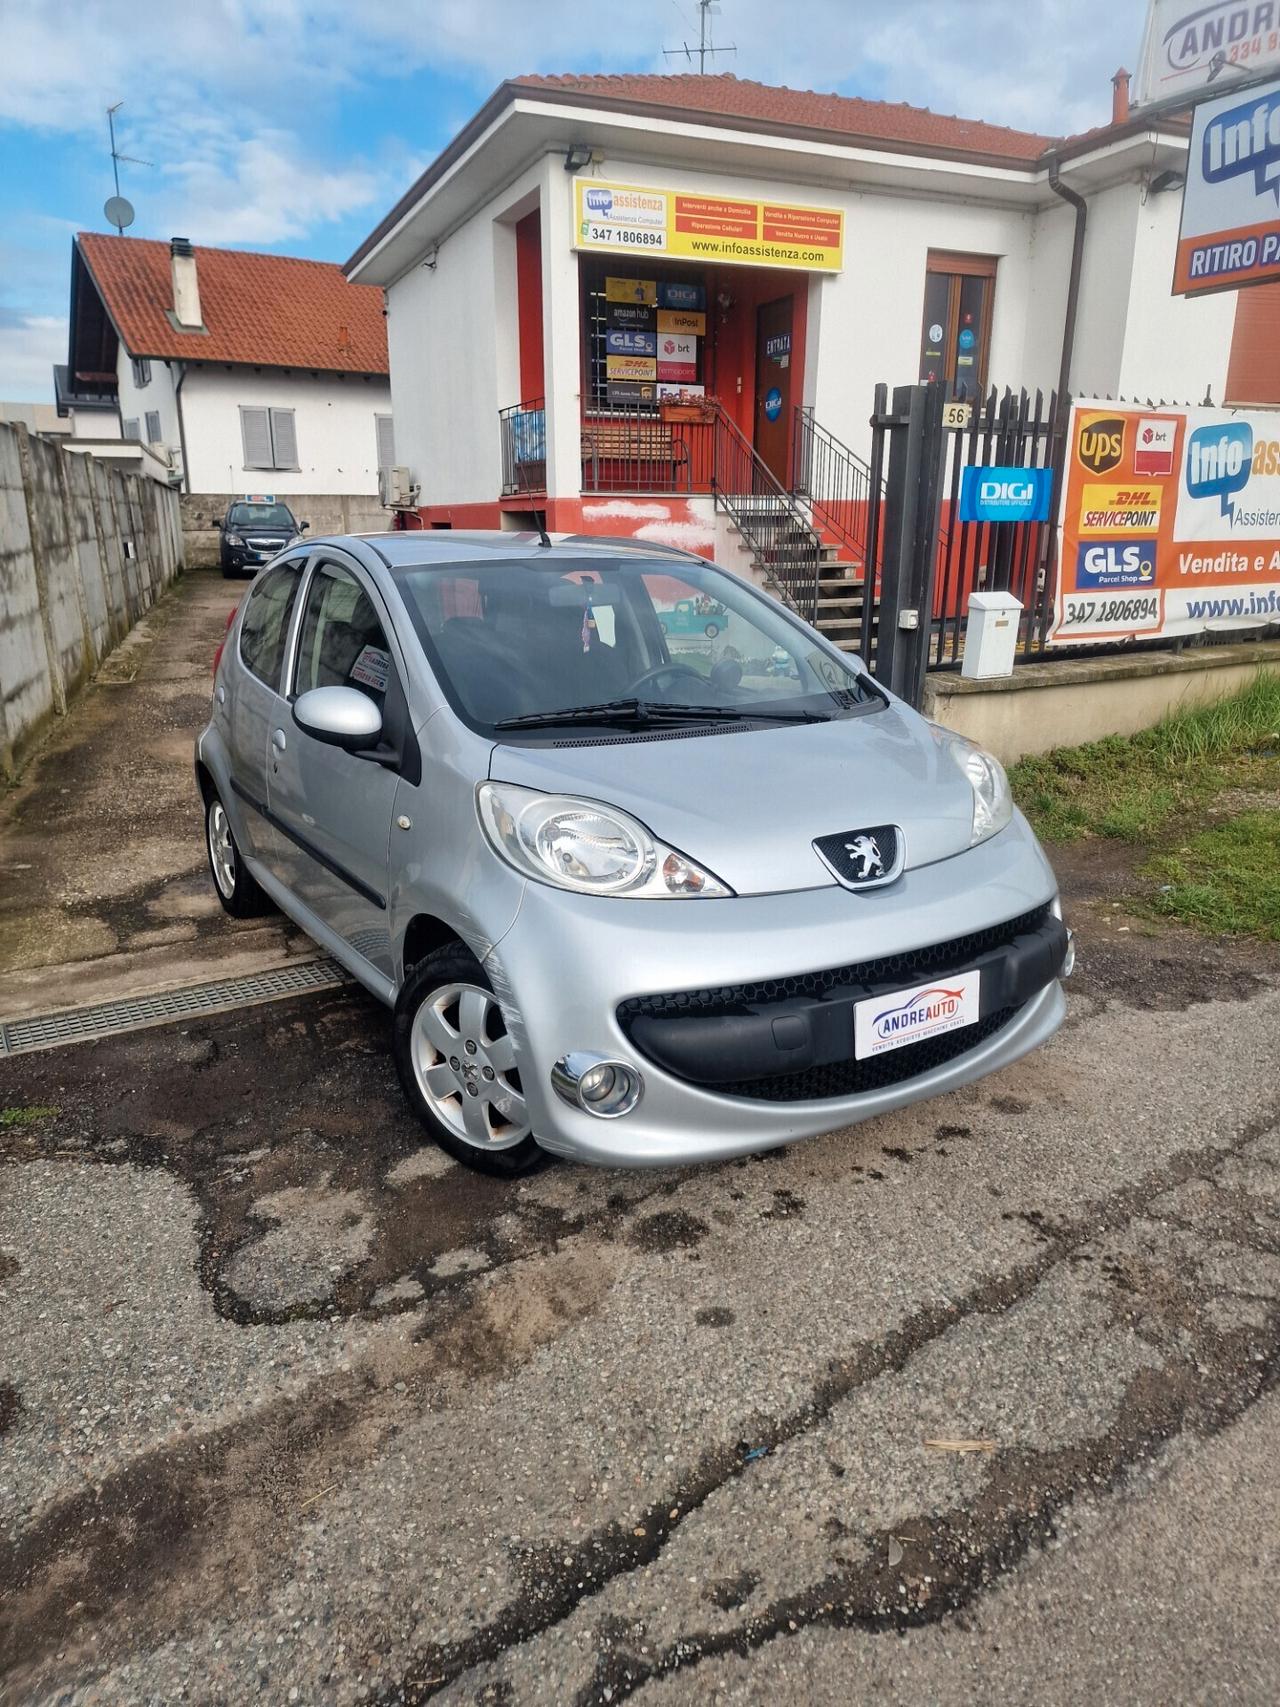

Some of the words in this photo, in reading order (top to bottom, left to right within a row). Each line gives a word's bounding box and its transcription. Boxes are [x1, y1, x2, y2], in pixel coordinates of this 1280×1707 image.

[1179, 1, 1280, 60] ANDR
[613, 194, 663, 211] assistenza
[609, 213, 637, 223] Assistenza
[765, 210, 783, 219] Vendita
[788, 212, 816, 223] Riparazione
[816, 215, 839, 226] Computer
[691, 221, 721, 231] Riparazione
[592, 228, 612, 241] 347
[617, 230, 662, 246] 1806894
[775, 230, 793, 239] Vendita
[691, 241, 824, 262] www.infoassistenza.com
[1190, 240, 1257, 278] RITIRO
[667, 289, 697, 301] DIGI
[614, 308, 636, 319] amazon
[637, 308, 649, 320] hub
[674, 317, 699, 328] InPost
[610, 333, 646, 348] GLS
[767, 335, 790, 354] ENTRATA
[677, 344, 690, 353] brt
[624, 360, 649, 368] DHL
[610, 367, 654, 378] SERVICEPOINT
[765, 398, 781, 409] DIGI
[949, 408, 964, 424] 56
[1155, 432, 1167, 442] brt
[1081, 433, 1121, 466] ups
[1252, 440, 1280, 477] as
[980, 482, 1034, 500] DIGI
[1115, 491, 1153, 506] DHL
[980, 499, 1010, 507] DISTRIBUTORE
[1083, 510, 1157, 527] SERVICEPOINT
[1179, 551, 1249, 575] Vendita
[1253, 555, 1265, 571] e
[1120, 575, 1138, 583] Shop
[1065, 602, 1096, 624] 347
[1095, 597, 1158, 623] 1806894
[883, 999, 955, 1034] ANDREAUTO
